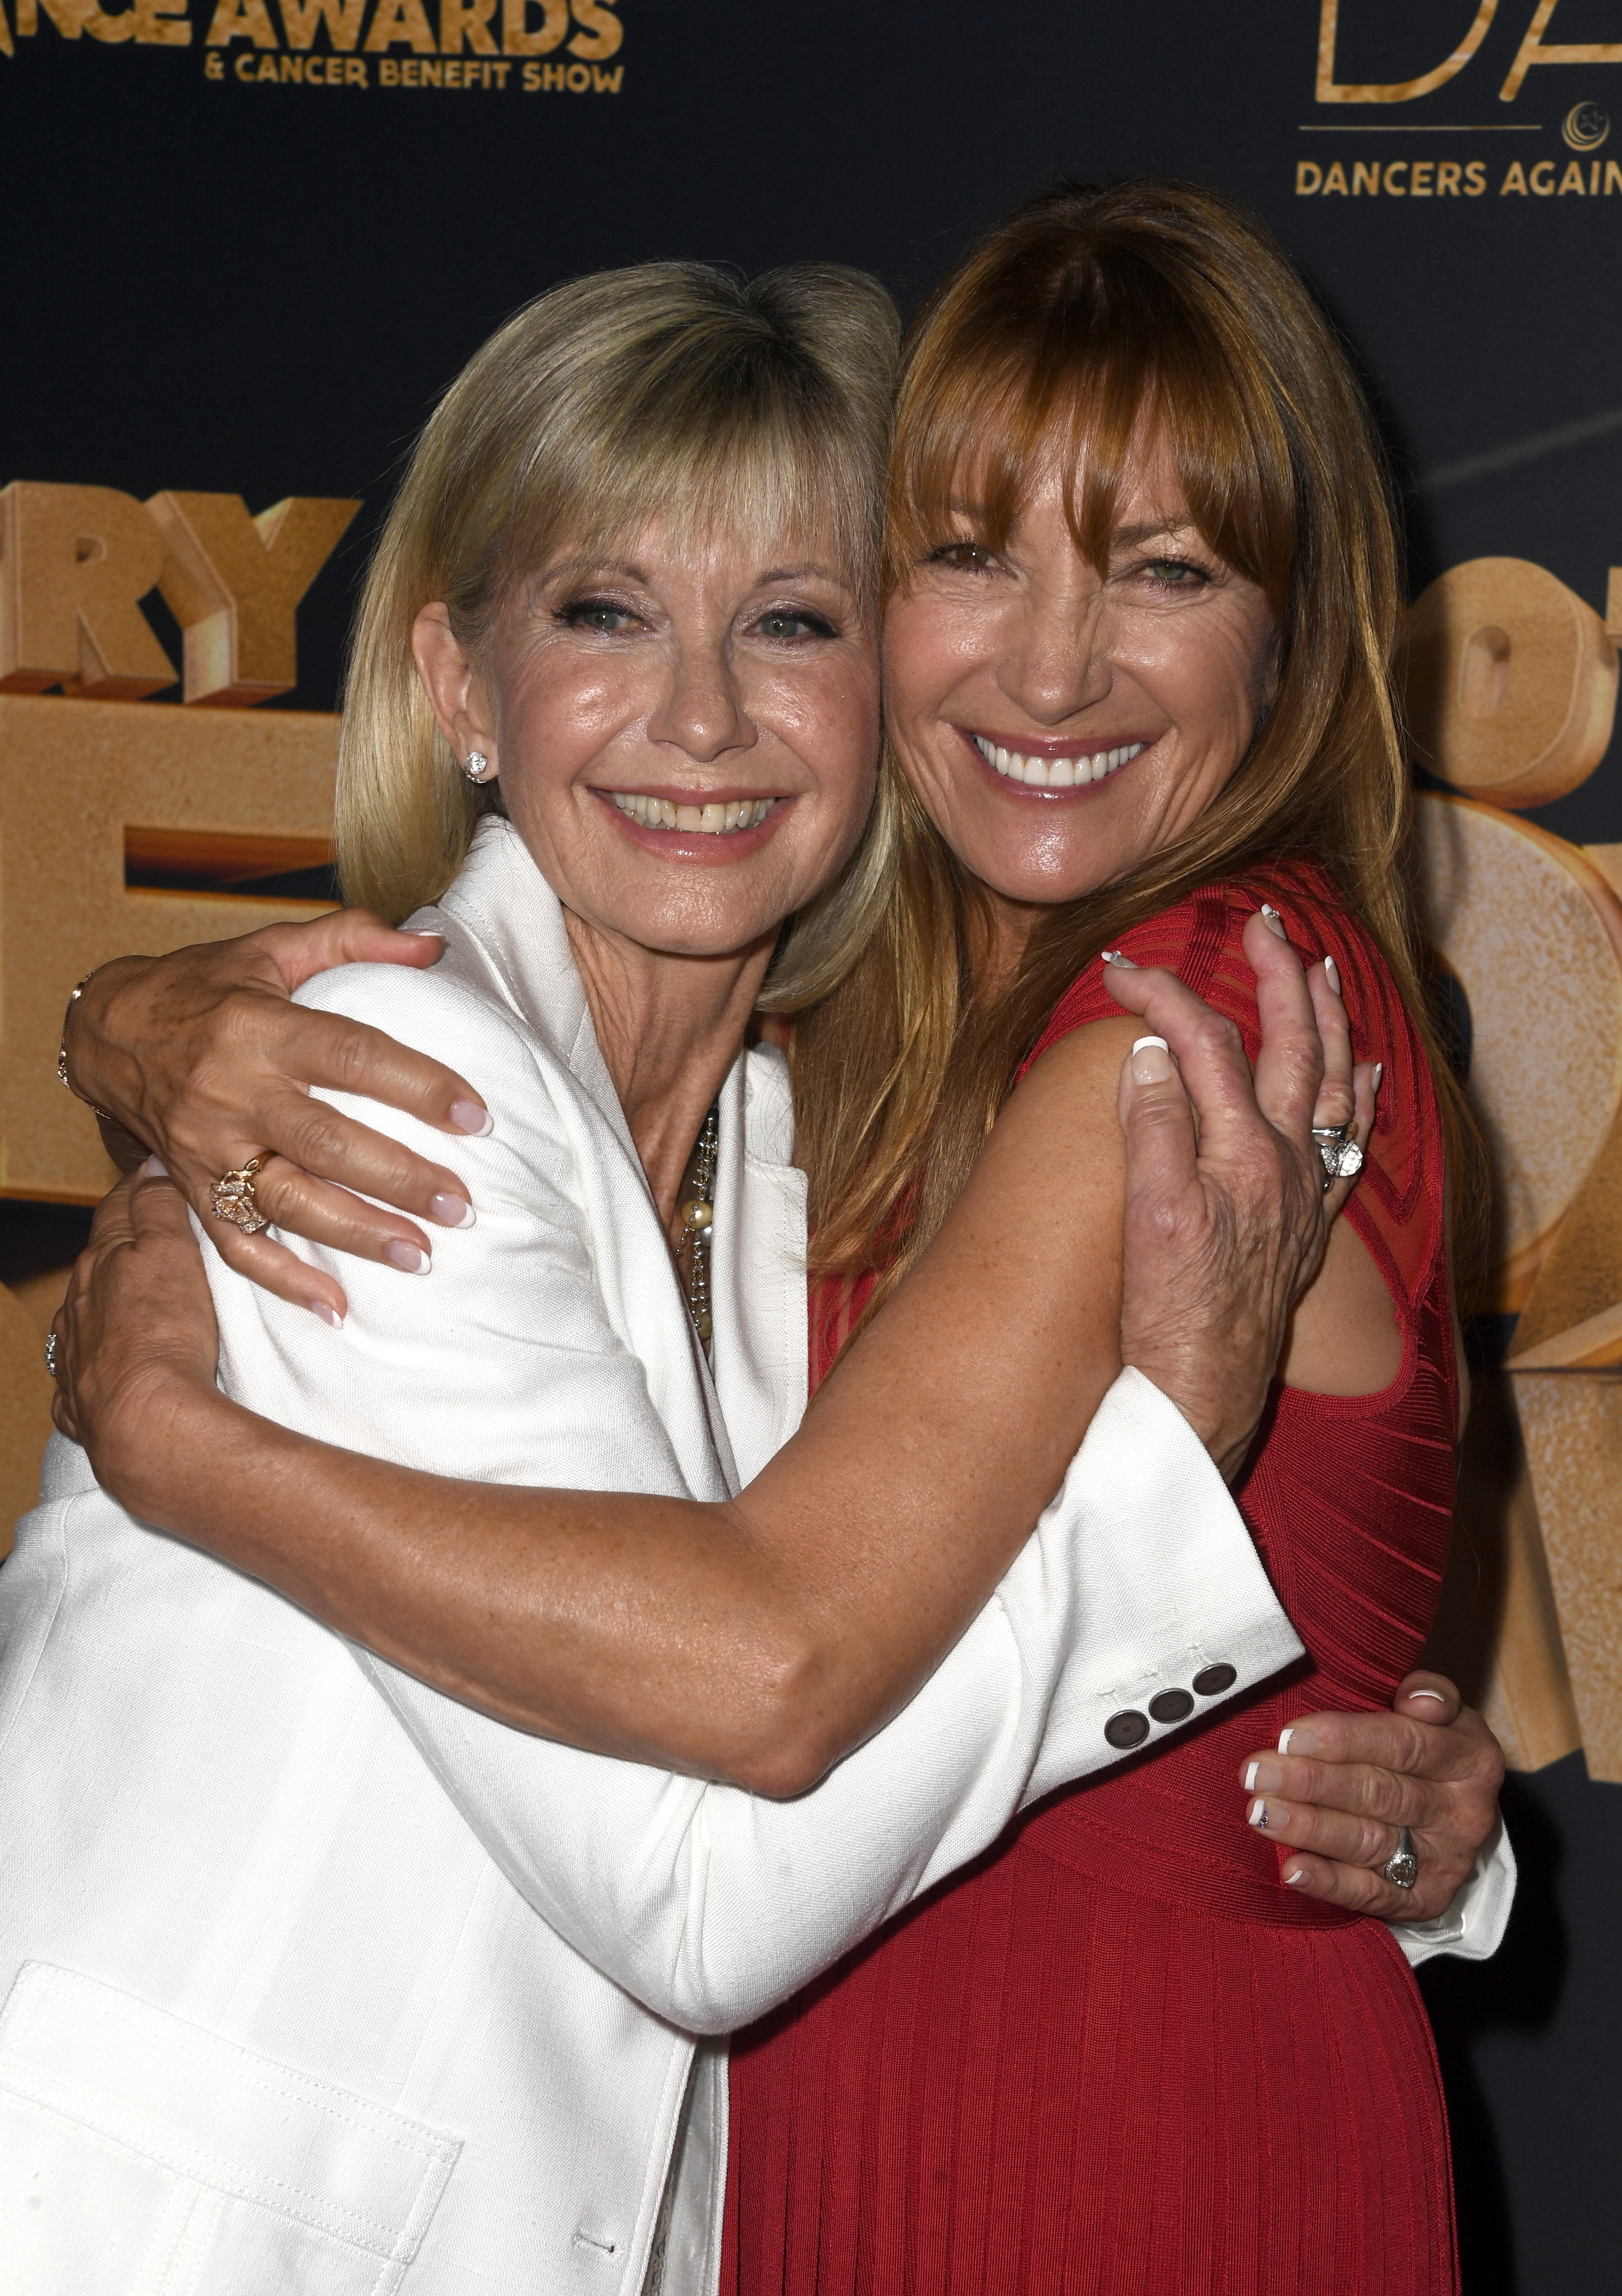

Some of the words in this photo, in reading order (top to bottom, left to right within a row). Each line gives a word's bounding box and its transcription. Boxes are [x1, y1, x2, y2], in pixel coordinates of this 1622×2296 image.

[204, 0, 624, 60] AWARDS
[204, 52, 224, 80] &
[235, 53, 369, 88] CANCER
[379, 59, 512, 89] BENEFIT
[522, 61, 624, 93] SHOW
[1296, 160, 1487, 196] DANCERS
[1500, 160, 1622, 196] AGAIN
